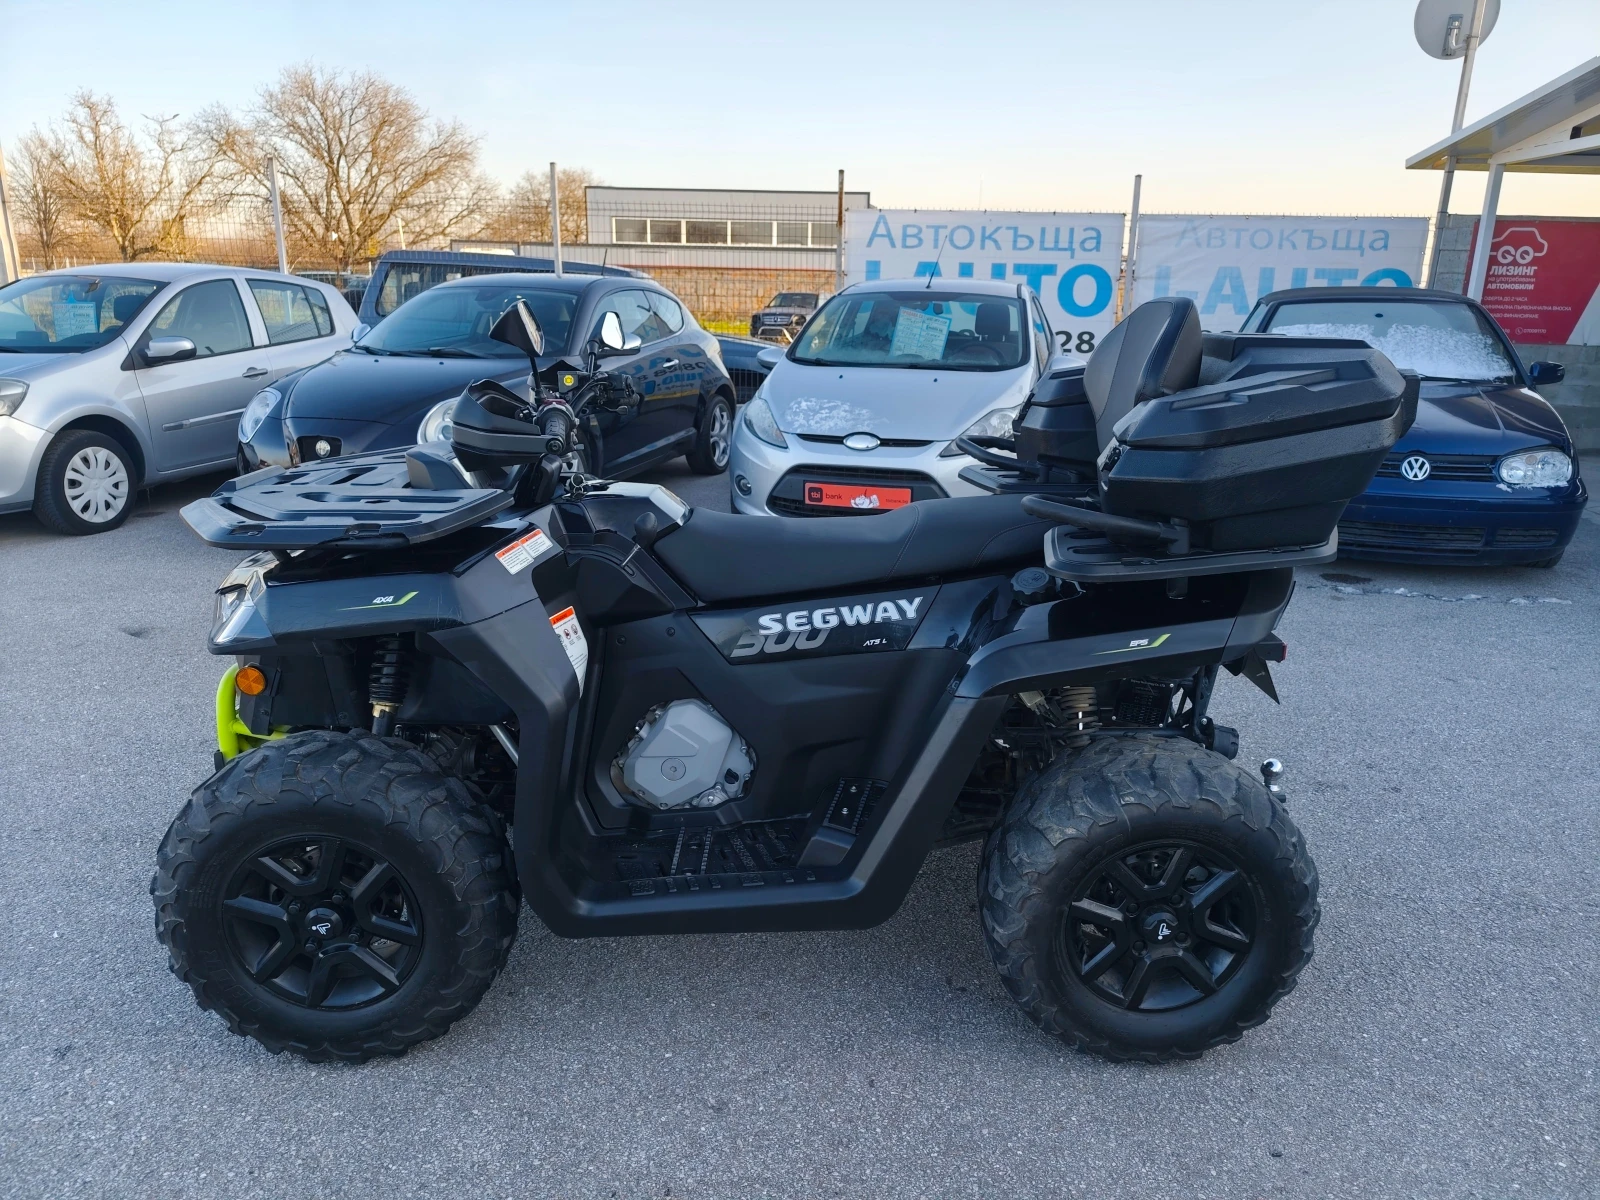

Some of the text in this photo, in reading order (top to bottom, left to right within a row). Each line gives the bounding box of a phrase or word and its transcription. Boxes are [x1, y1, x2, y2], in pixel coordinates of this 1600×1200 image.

[866, 214, 1103, 259] Автокъща
[1175, 219, 1390, 257] Автокъща
[1489, 266, 1538, 276] ЛИЗИНГ
[811, 491, 821, 499] tbi
[825, 492, 843, 500] bank
[758, 597, 923, 635] SEGWAY
